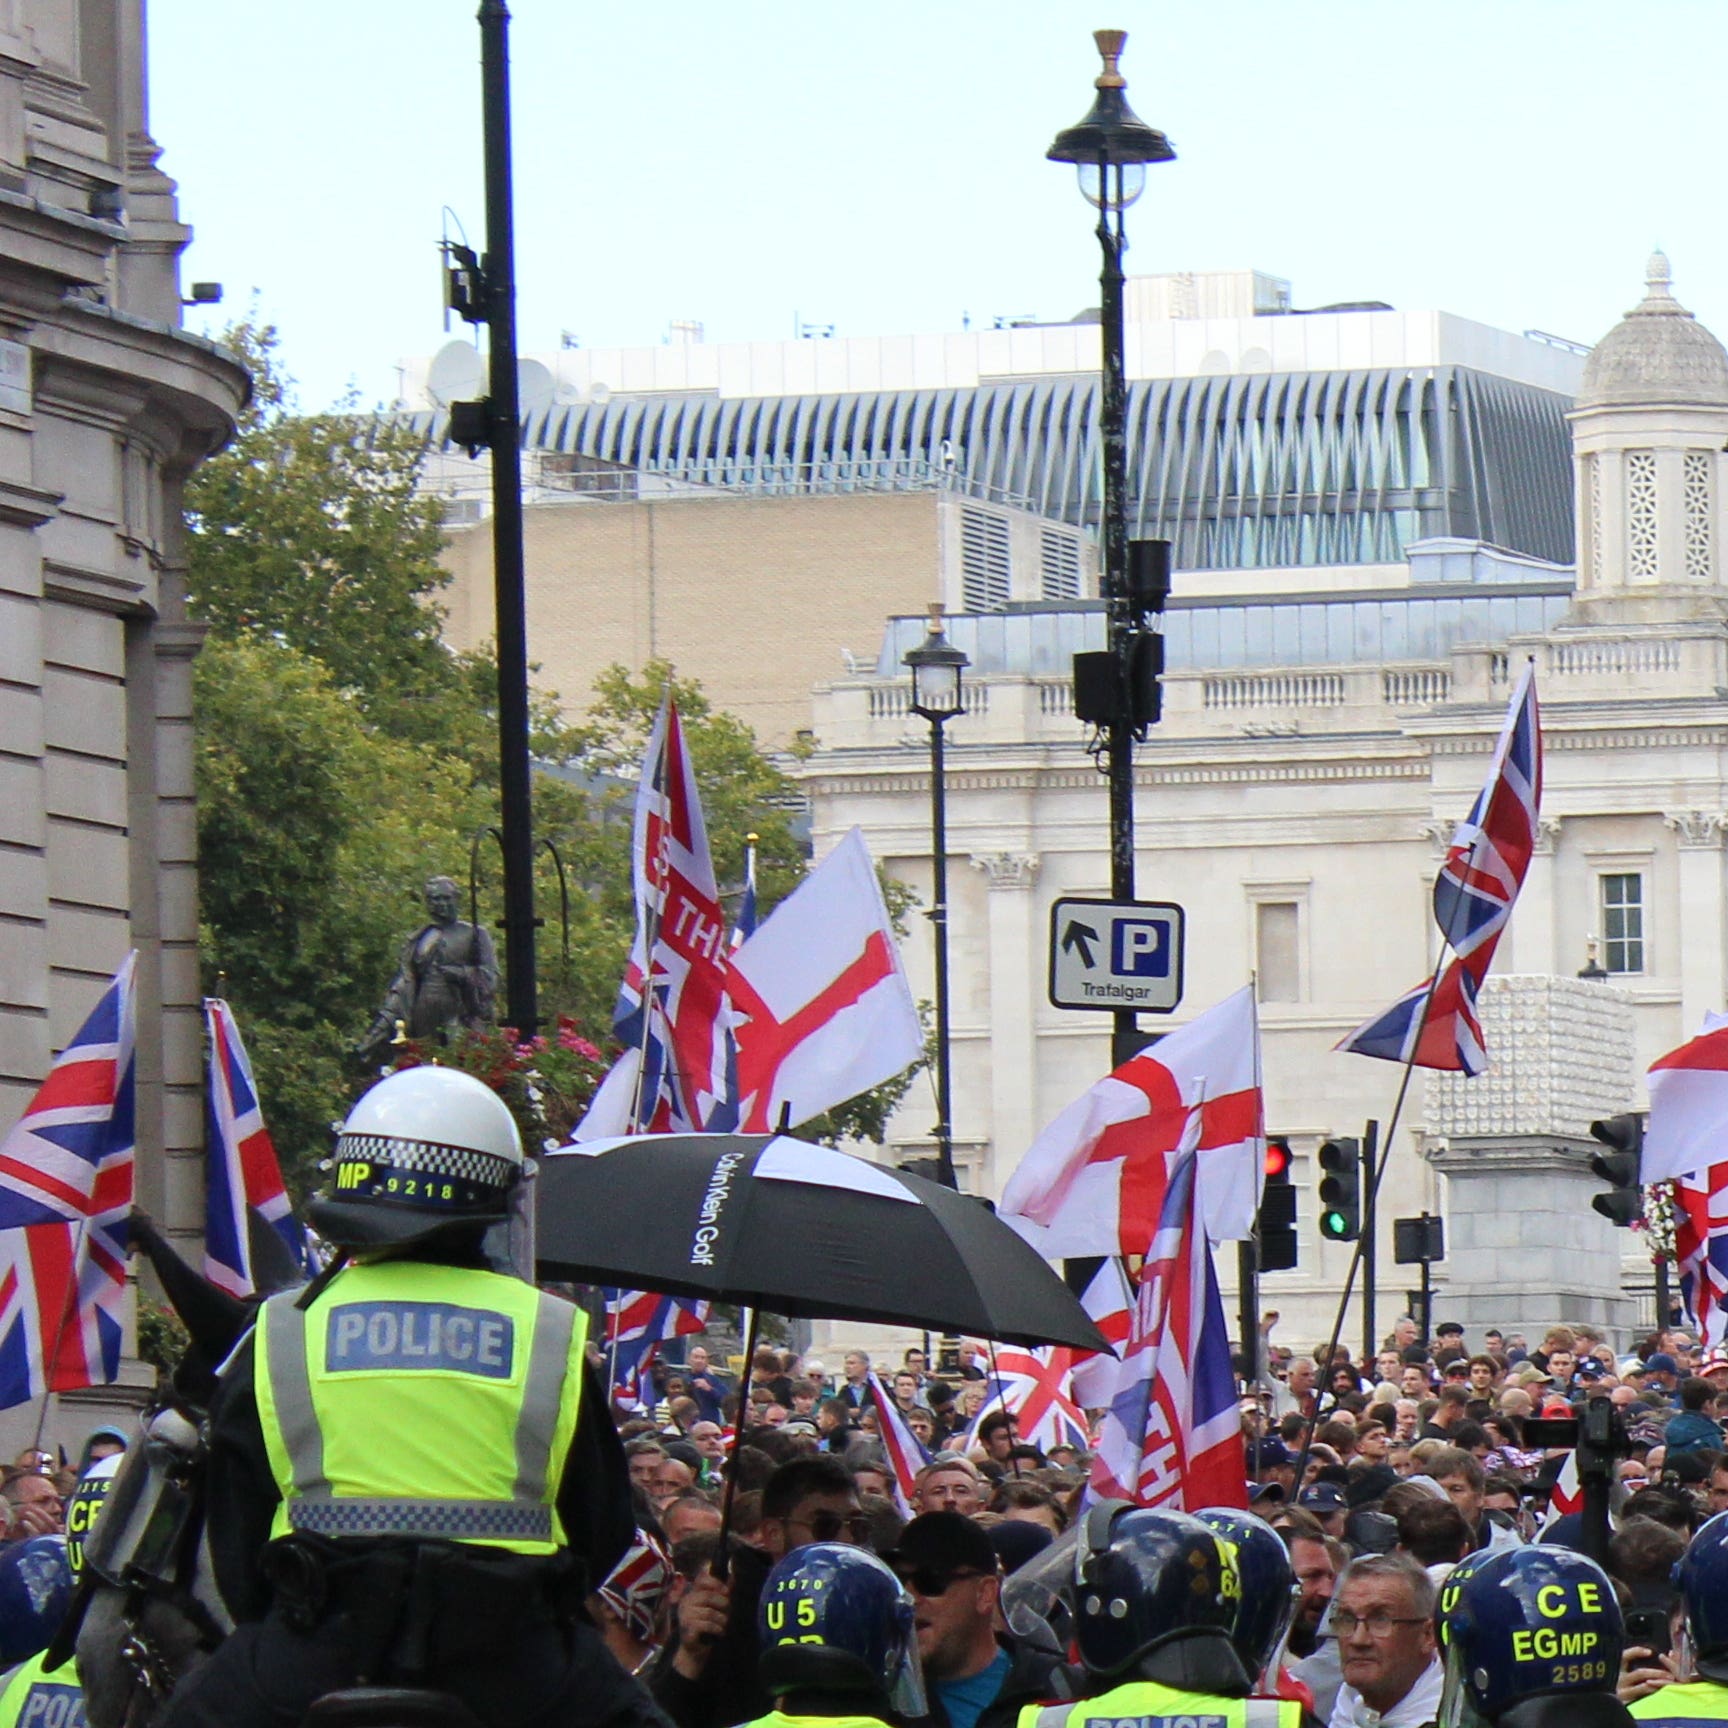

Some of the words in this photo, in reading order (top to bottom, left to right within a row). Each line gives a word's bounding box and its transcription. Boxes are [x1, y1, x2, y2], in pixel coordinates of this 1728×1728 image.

[1122, 924, 1158, 971] P
[1081, 982, 1151, 1001] Trafalgar
[337, 1162, 370, 1190] MP
[387, 1177, 454, 1200] 9218
[690, 1226, 719, 1265] Golf
[335, 1307, 510, 1369] POLICE
[797, 1597, 816, 1627] 5
[1552, 1661, 1607, 1684] 2589
